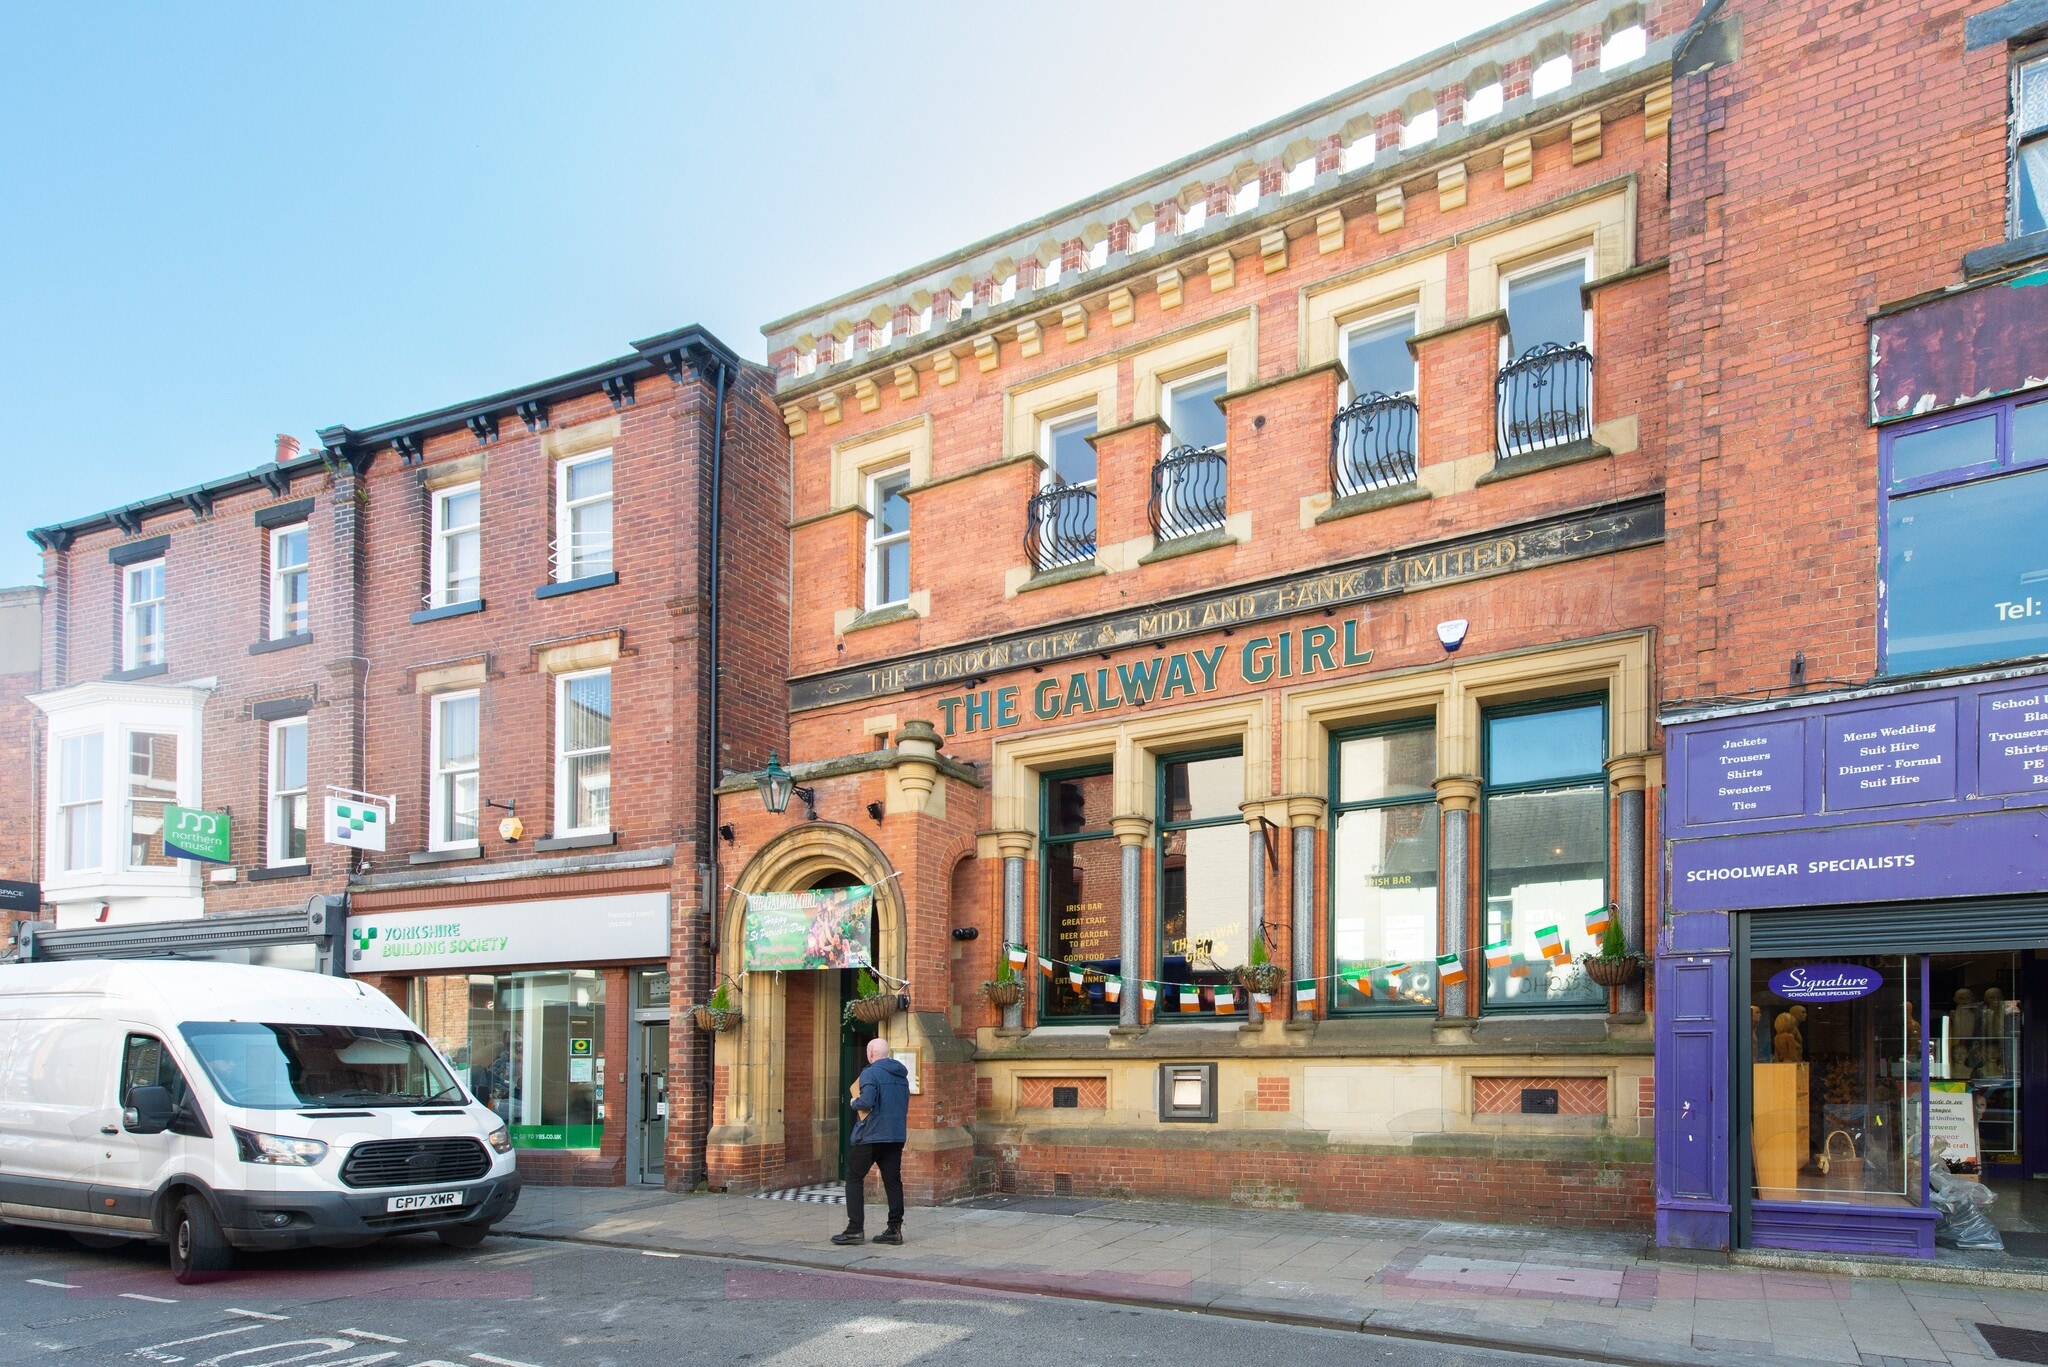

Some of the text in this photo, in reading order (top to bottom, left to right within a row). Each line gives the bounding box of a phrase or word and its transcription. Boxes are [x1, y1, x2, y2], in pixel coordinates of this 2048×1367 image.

[868, 670, 908, 692] THE
[922, 645, 1009, 681] LONDON
[1027, 631, 1079, 660] CITY
[1099, 625, 1116, 643] &
[1278, 573, 1357, 609] BANK
[1384, 540, 1516, 587] LIMITED
[1994, 597, 2041, 621] Tel:
[937, 619, 1375, 736] THE GALWAY GIRL
[1992, 696, 2039, 711] School
[1843, 723, 1936, 742] Mens Wedding
[1723, 737, 1767, 749] Jackets
[1860, 742, 1919, 756] Suit Hire
[1719, 753, 1771, 765] Trousers
[1839, 763, 1884, 776] Dinner
[1895, 755, 1942, 768] Formal
[2023, 759, 2044, 770] PE
[1727, 769, 1763, 779] Shirts
[1860, 775, 1920, 789] Suit Hire
[1719, 784, 1771, 796] Sweaters
[1732, 801, 1757, 810] Ties
[172, 832, 222, 845] northern
[180, 842, 214, 853] music
[1687, 854, 1915, 882] SCHOOLWEAR SPECIALISTS
[1392, 875, 1412, 885] BAR
[750, 893, 818, 911] THE GALWAY GIRL
[1066, 902, 1102, 912] IRISH BAR
[764, 915, 787, 926] Happy
[1062, 916, 1107, 926] GREAT CRAIC
[384, 923, 460, 941] YORKSHIRE
[750, 931, 759, 942] St
[791, 923, 806, 934] Day
[1060, 930, 1109, 940] BEER GARDEN
[382, 936, 508, 957] BUILDING SOCIETY
[1069, 939, 1099, 948] TO REAR
[1172, 937, 1193, 953] THE
[1063, 953, 1105, 962] GOOD FOOD
[1185, 945, 1211, 963] GIRL
[1782, 968, 1868, 992] Signature
[395, 1193, 455, 1209] CP17 XWR
